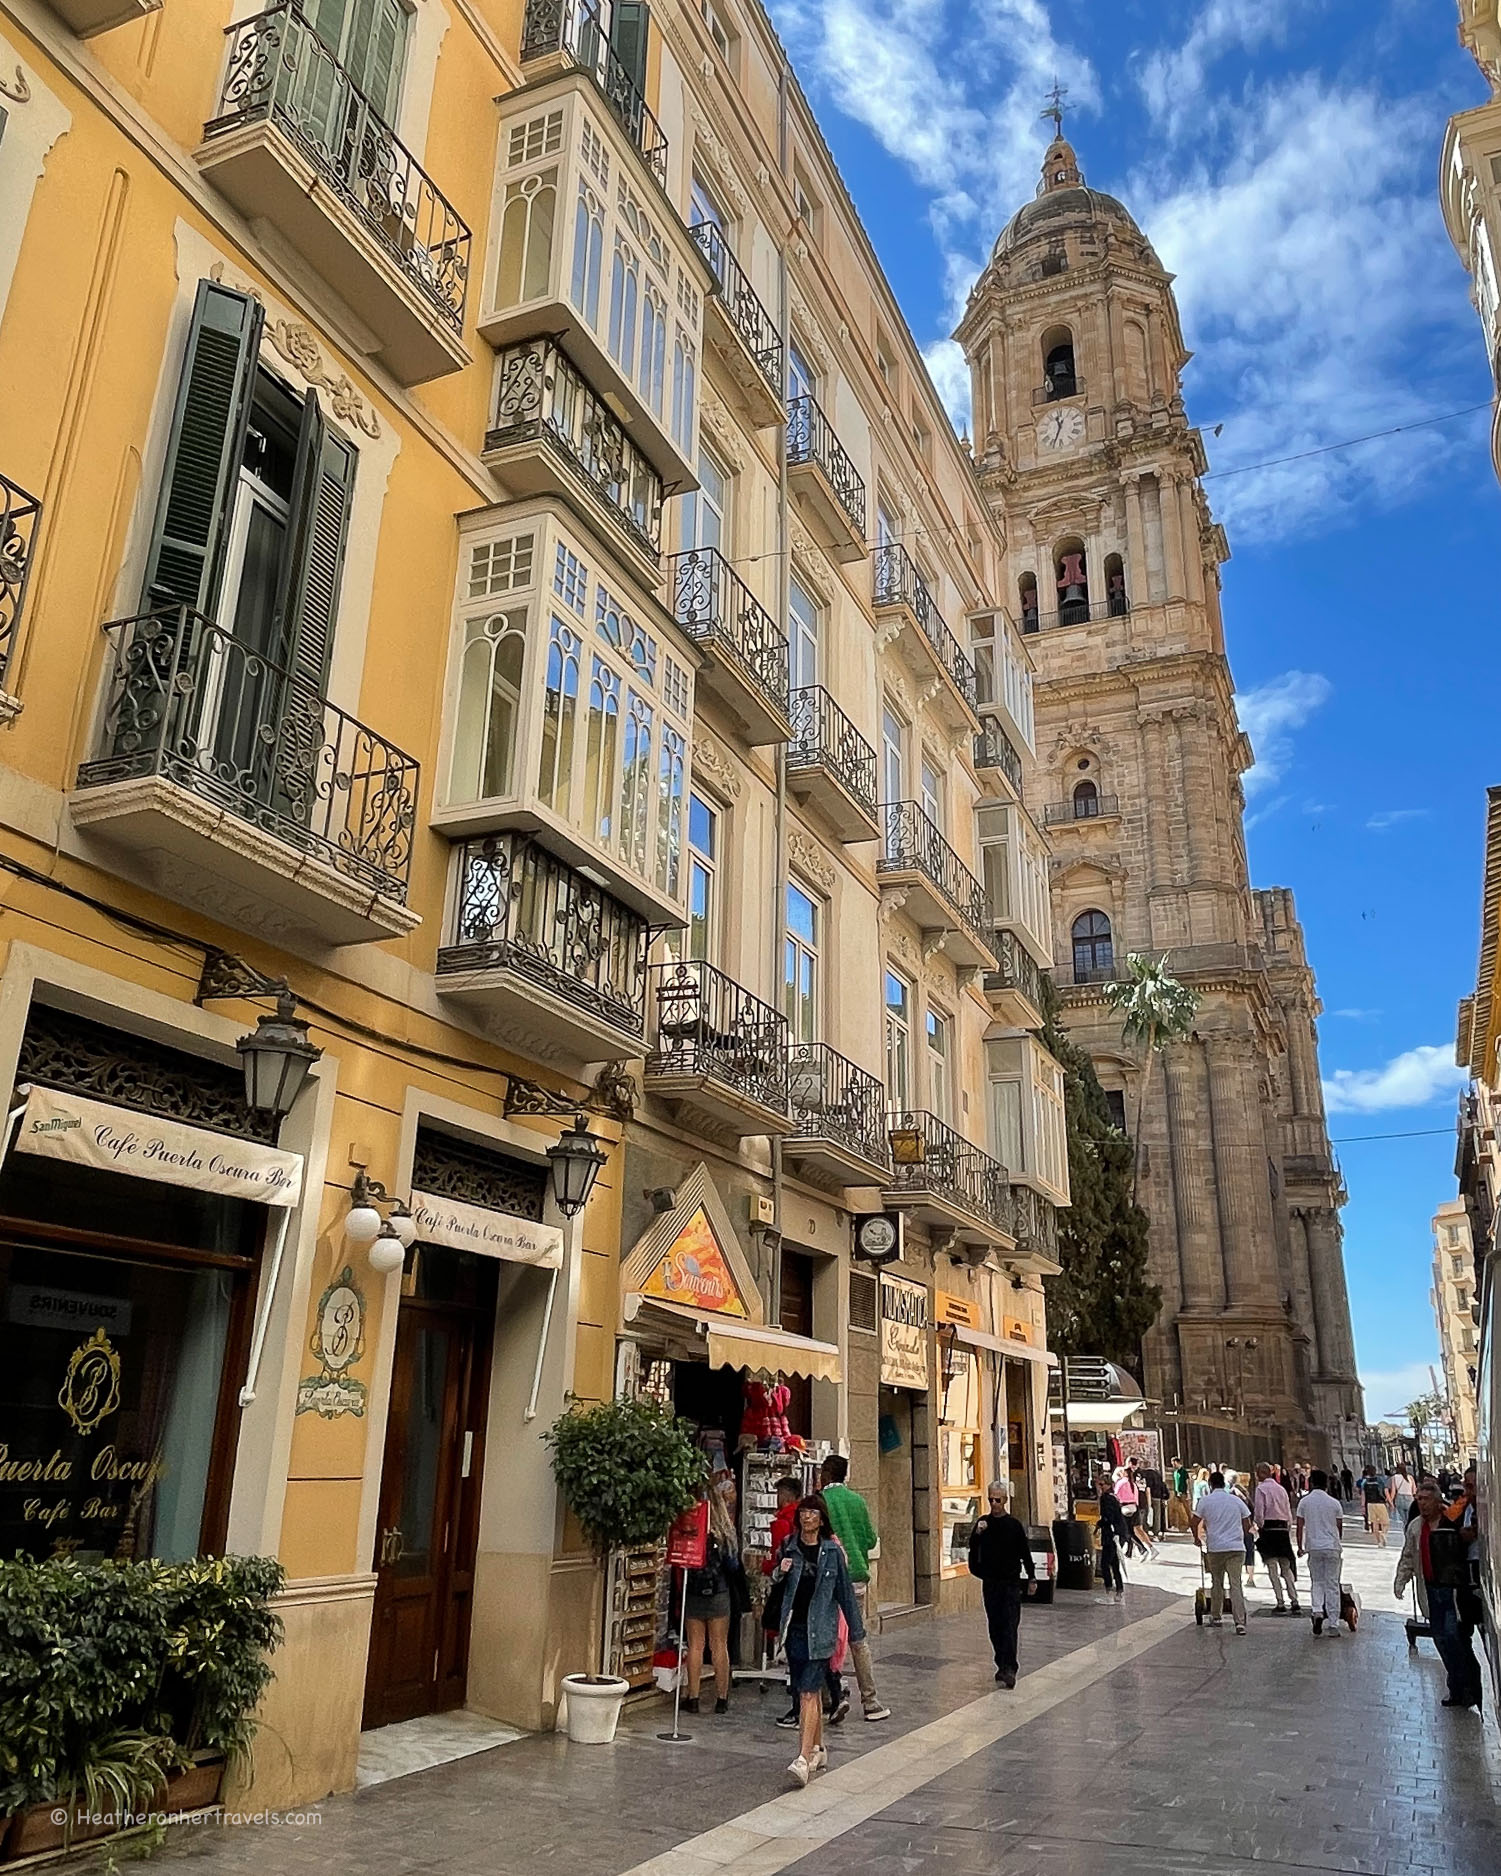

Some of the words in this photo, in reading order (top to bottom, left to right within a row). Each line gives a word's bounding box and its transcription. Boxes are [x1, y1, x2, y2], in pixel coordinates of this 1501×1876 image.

[93, 1124, 140, 1160] Café
[142, 1138, 204, 1171] Puerta
[208, 1154, 262, 1182] Oscura
[0, 1444, 72, 1481] uerta
[23, 1499, 72, 1529] Café
[80, 1497, 118, 1519] Bar
